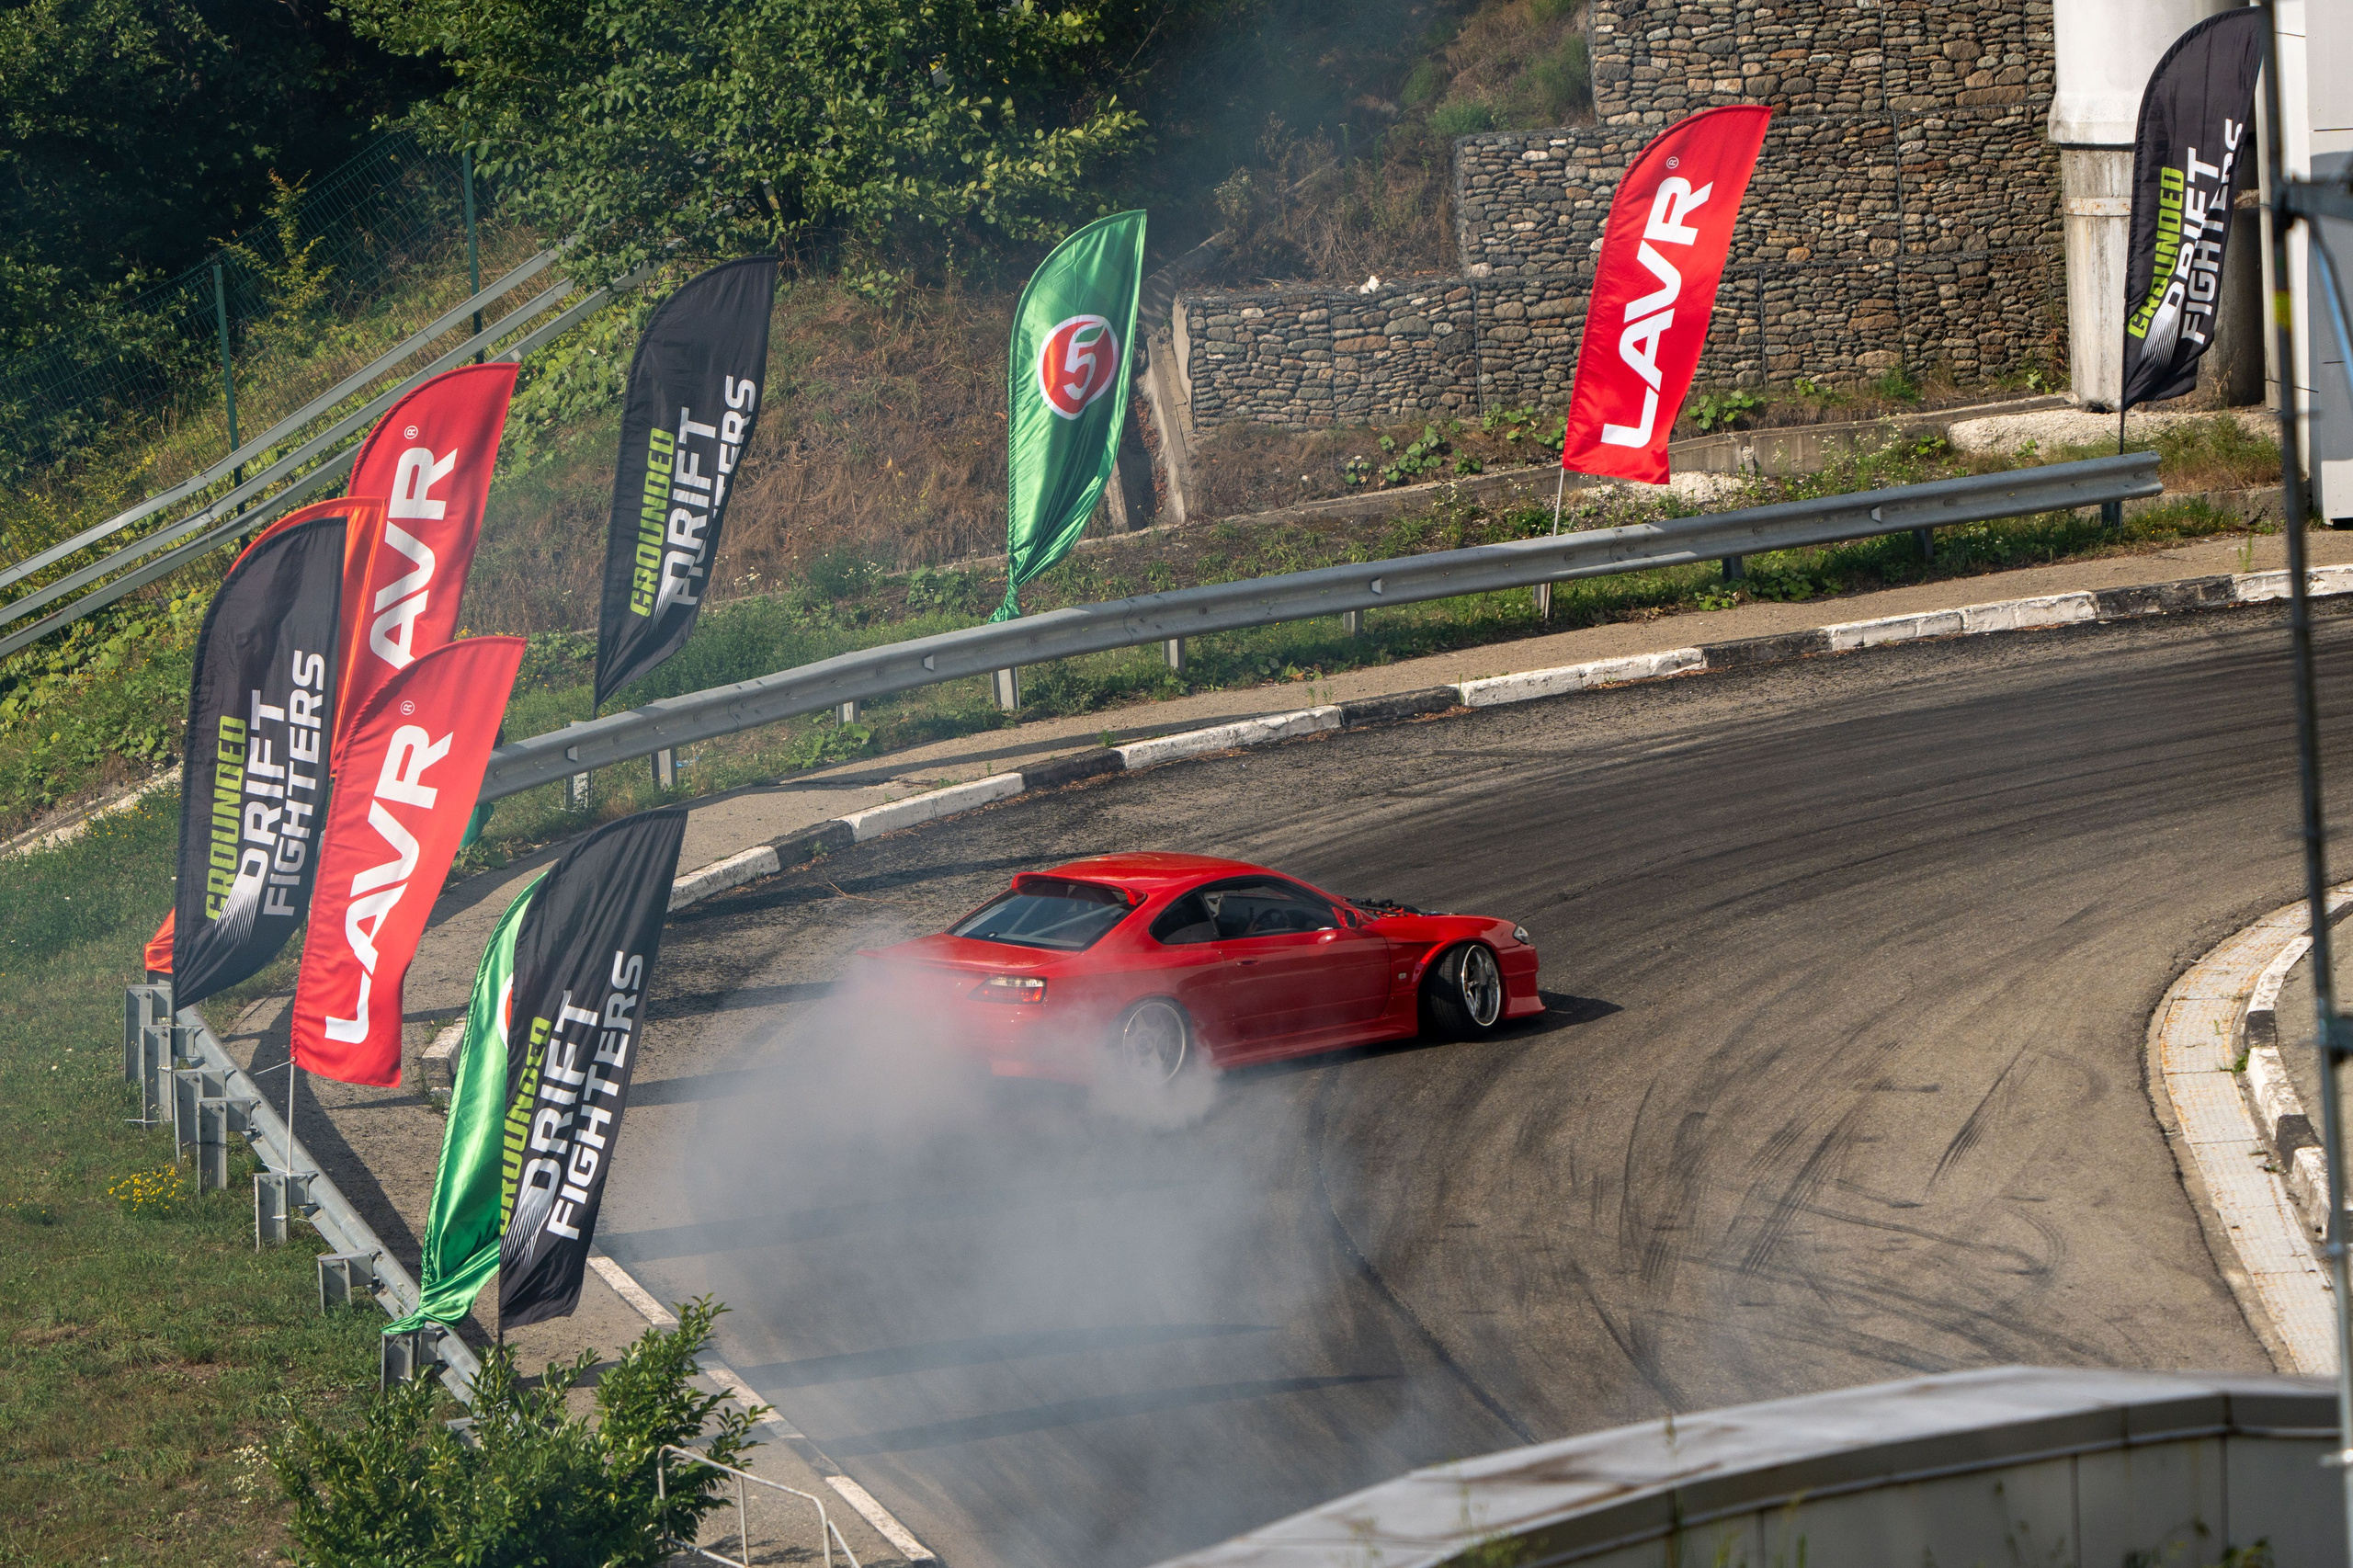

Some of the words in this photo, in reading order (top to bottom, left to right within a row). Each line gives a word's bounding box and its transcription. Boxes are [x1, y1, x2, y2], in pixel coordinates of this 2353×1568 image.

[2128, 166, 2184, 339] GROUNDED
[2149, 146, 2219, 340] DRIFT
[1063, 323, 1105, 401] 5
[369, 447, 458, 670] AVR
[630, 427, 675, 617] GROUNDED
[654, 406, 716, 616] DRIFT
[206, 715, 246, 920] GROUNDED
[219, 689, 285, 924] DRIFT
[263, 650, 324, 915] FIGHTERS
[507, 990, 598, 1233] DRIFT
[546, 949, 643, 1241] FIGHTERS
